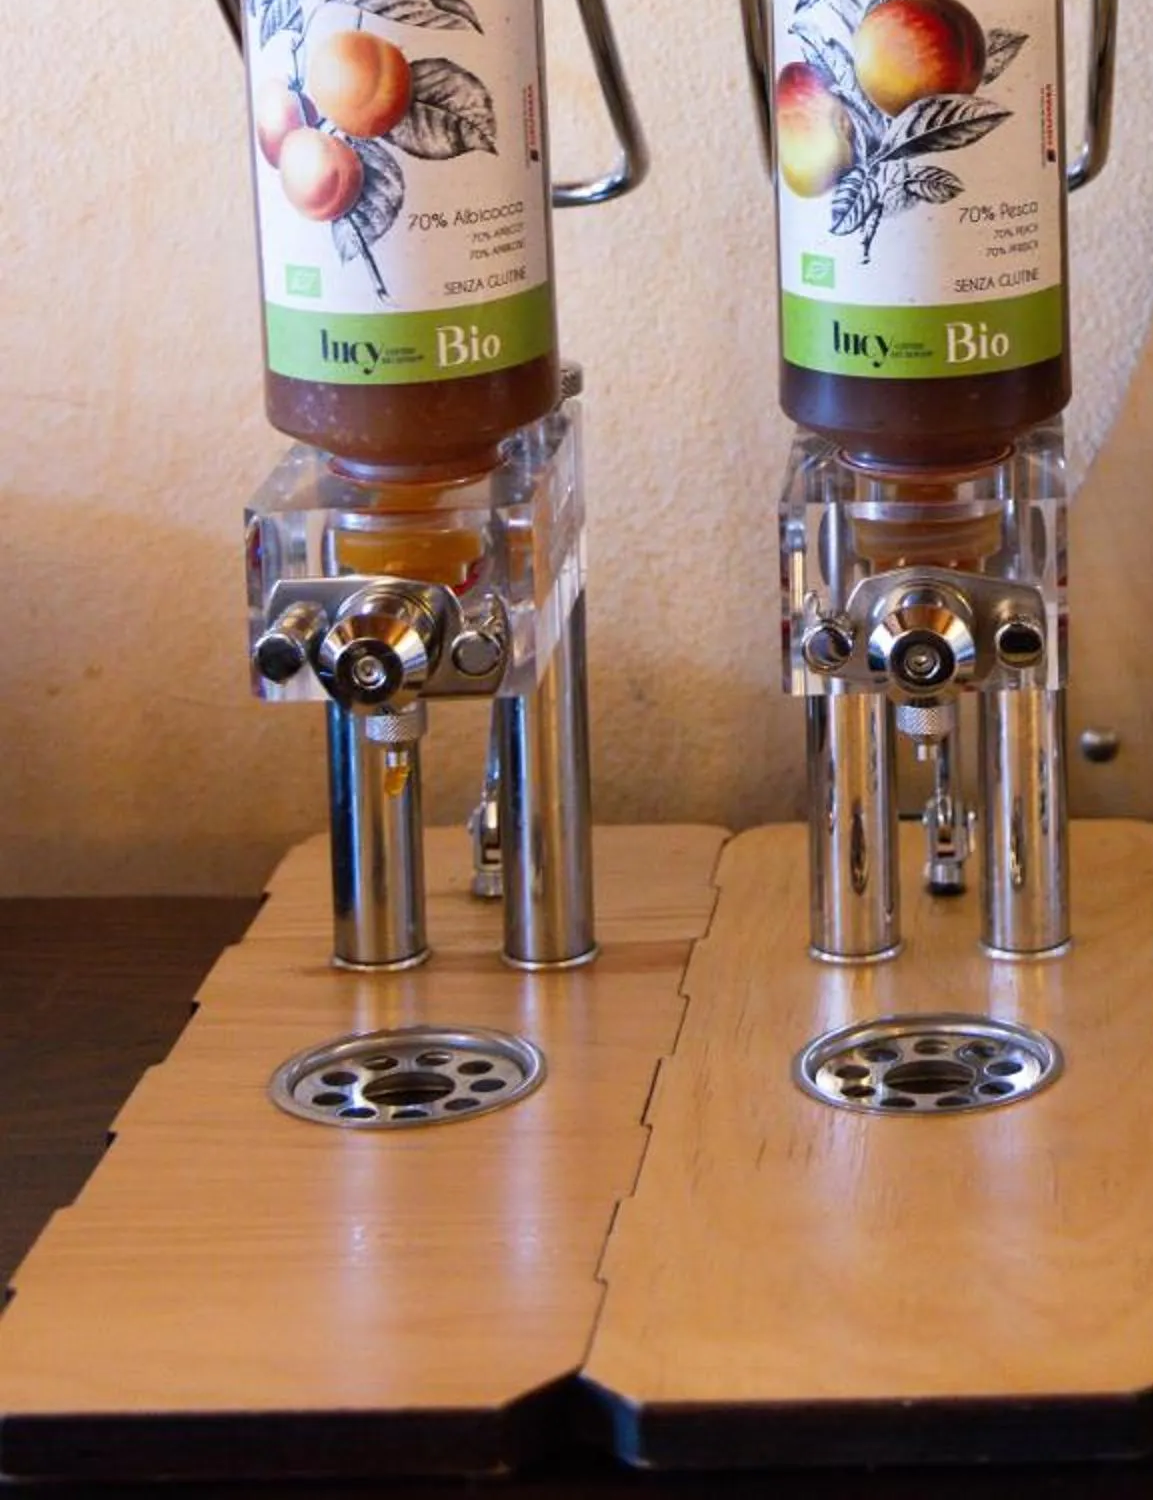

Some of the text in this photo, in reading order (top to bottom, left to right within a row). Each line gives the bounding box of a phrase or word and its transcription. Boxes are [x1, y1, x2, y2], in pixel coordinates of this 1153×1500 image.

[407, 200, 524, 231] 70% Albicocca
[958, 201, 1039, 224] 70% Pesca
[443, 278, 485, 296] SENZA
[953, 276, 995, 293] SENZA
[320, 325, 501, 375] lucy Bio
[833, 320, 1009, 368] lucy Bio
